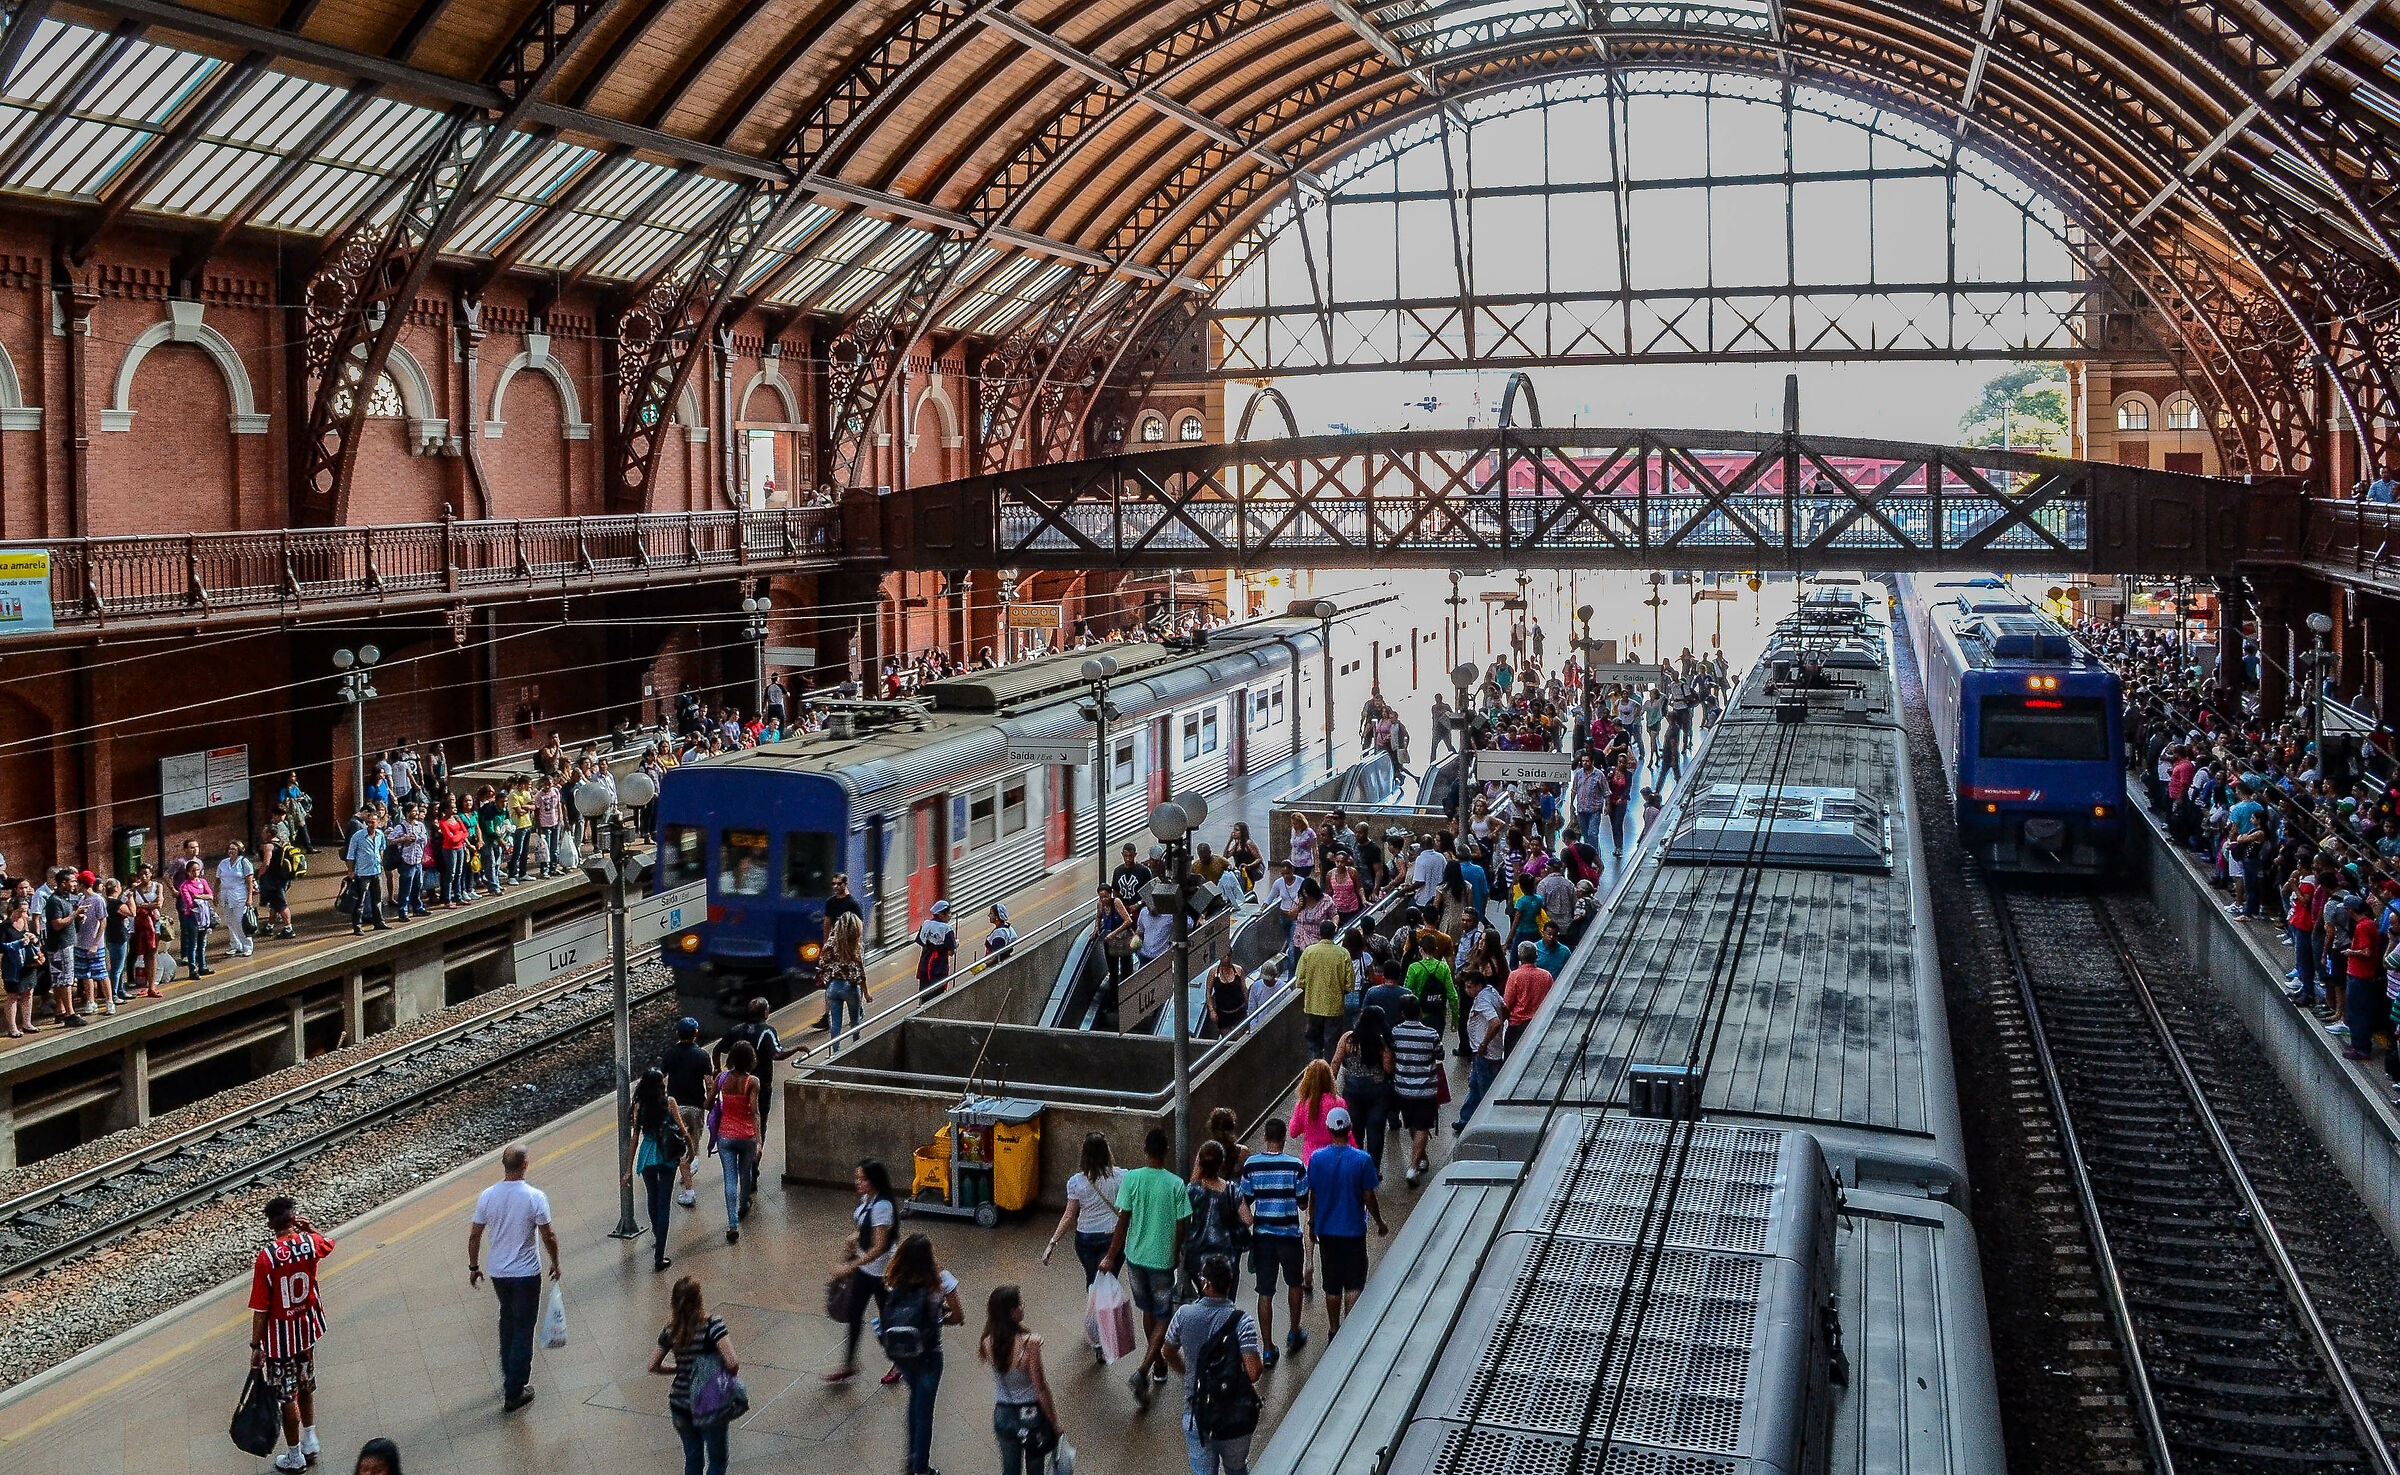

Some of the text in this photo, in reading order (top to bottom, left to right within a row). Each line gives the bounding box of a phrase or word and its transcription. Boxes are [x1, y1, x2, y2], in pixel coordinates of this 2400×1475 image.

[10, 560, 46, 570] amarela
[1010, 751, 1035, 761] Saída
[1517, 768, 1547, 778] Saída
[1553, 771, 1567, 779] Exit
[549, 948, 577, 971] Luz
[292, 1242, 311, 1257] LG
[280, 1271, 310, 1309] 10
